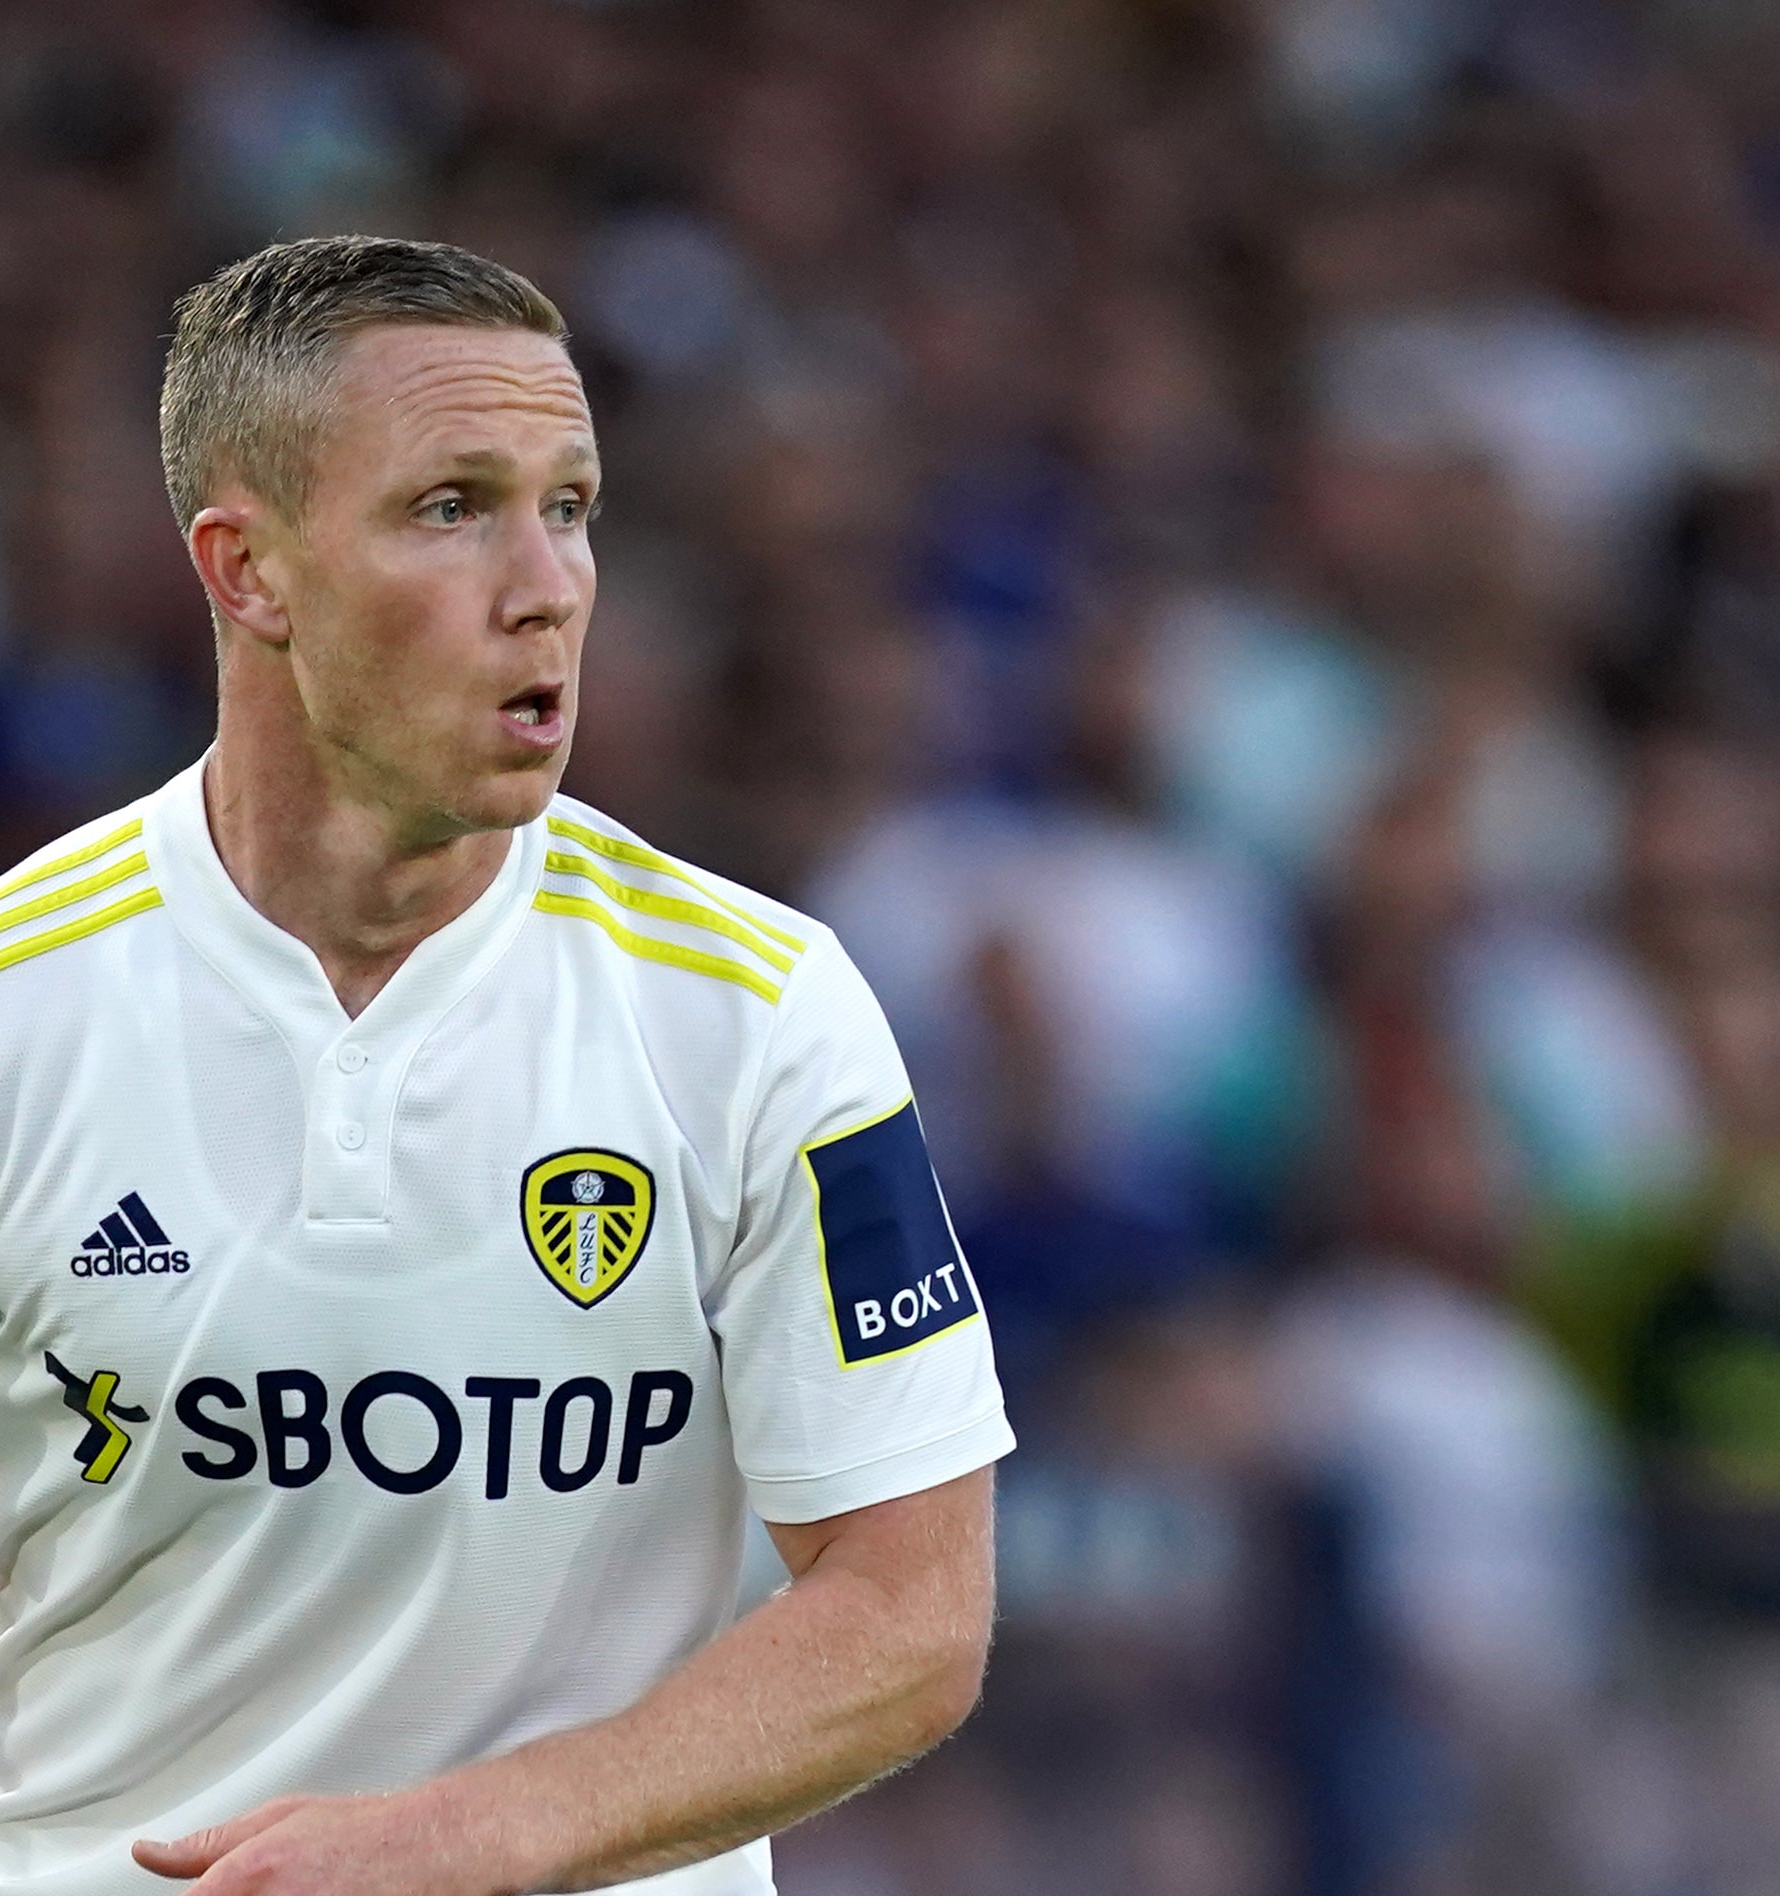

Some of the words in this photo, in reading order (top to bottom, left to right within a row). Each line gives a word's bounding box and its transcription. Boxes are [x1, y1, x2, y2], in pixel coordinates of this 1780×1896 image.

[70, 1247, 191, 1279] adidas
[853, 1262, 957, 1341] BOXT
[173, 1368, 695, 1501] SBOTOP
